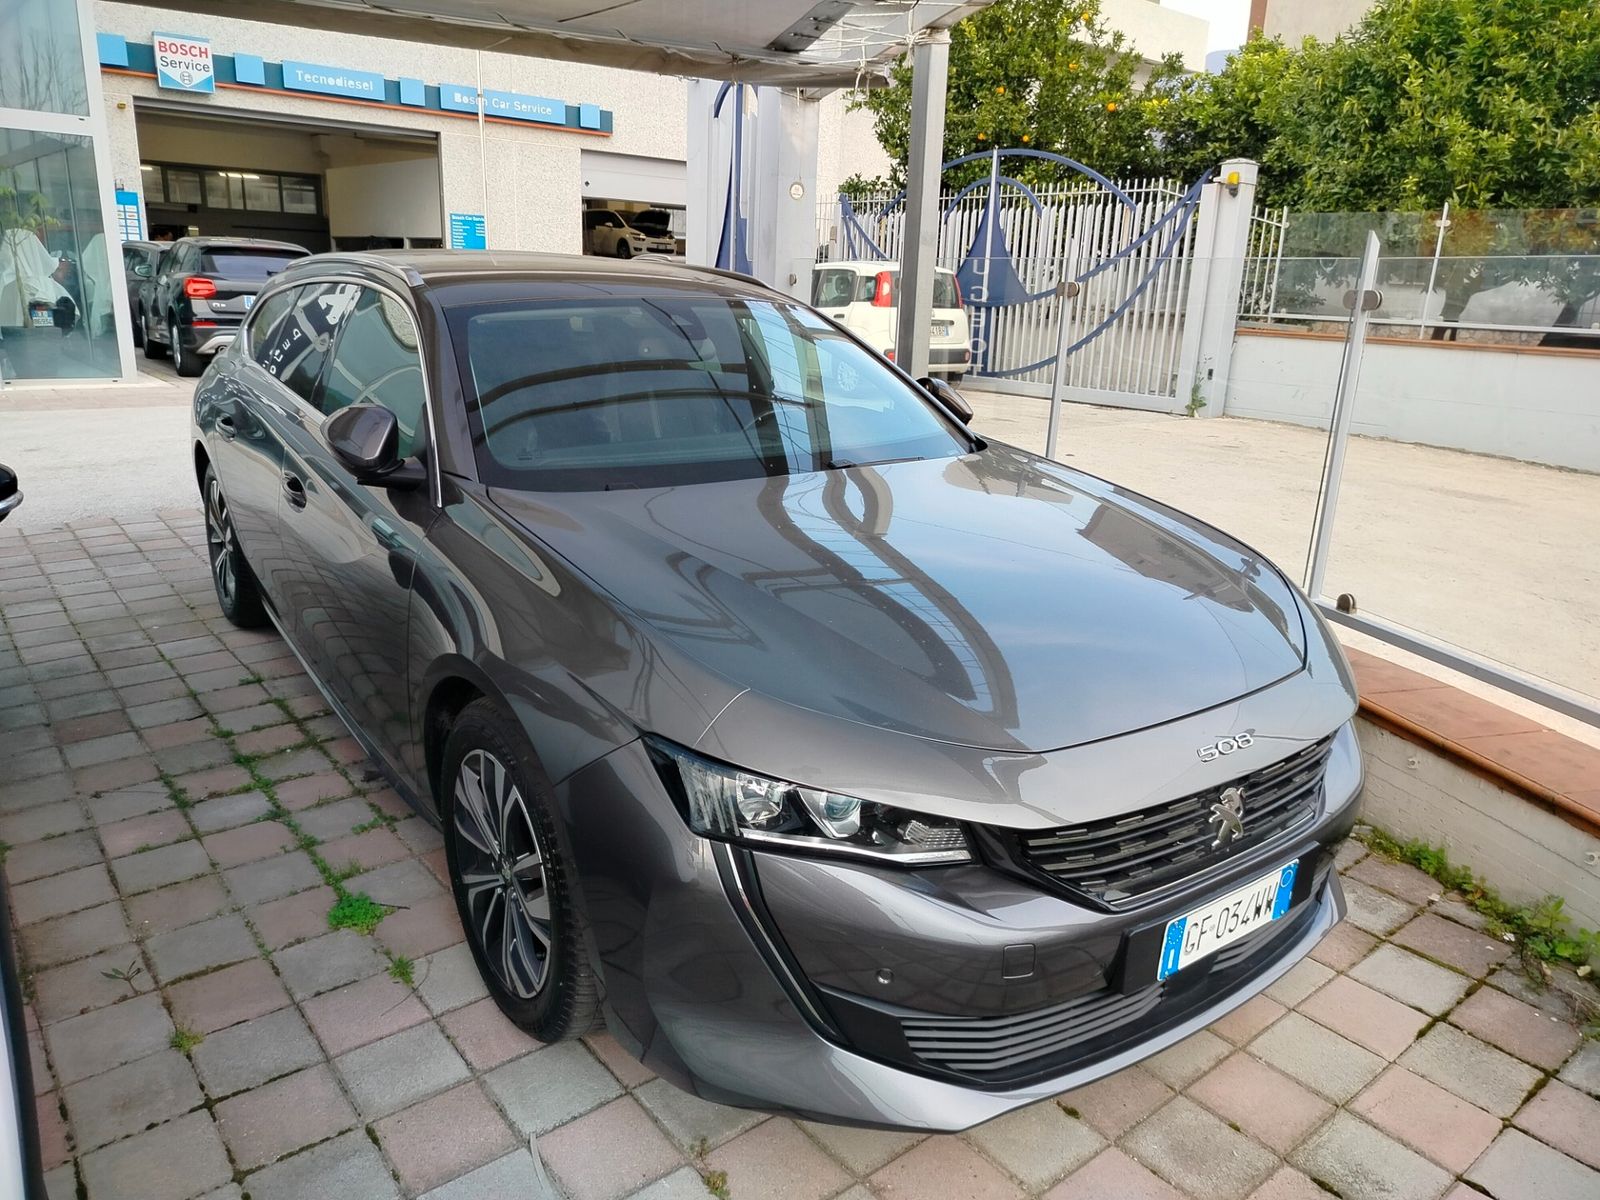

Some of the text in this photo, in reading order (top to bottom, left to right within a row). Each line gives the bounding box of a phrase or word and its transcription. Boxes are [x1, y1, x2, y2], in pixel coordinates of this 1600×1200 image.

[158, 41, 208, 58] BOSCH
[160, 56, 210, 72] Service
[296, 70, 373, 91] Tecnodiesel
[492, 98, 510, 109] Car
[513, 101, 552, 115] Service
[1197, 733, 1253, 762] 508
